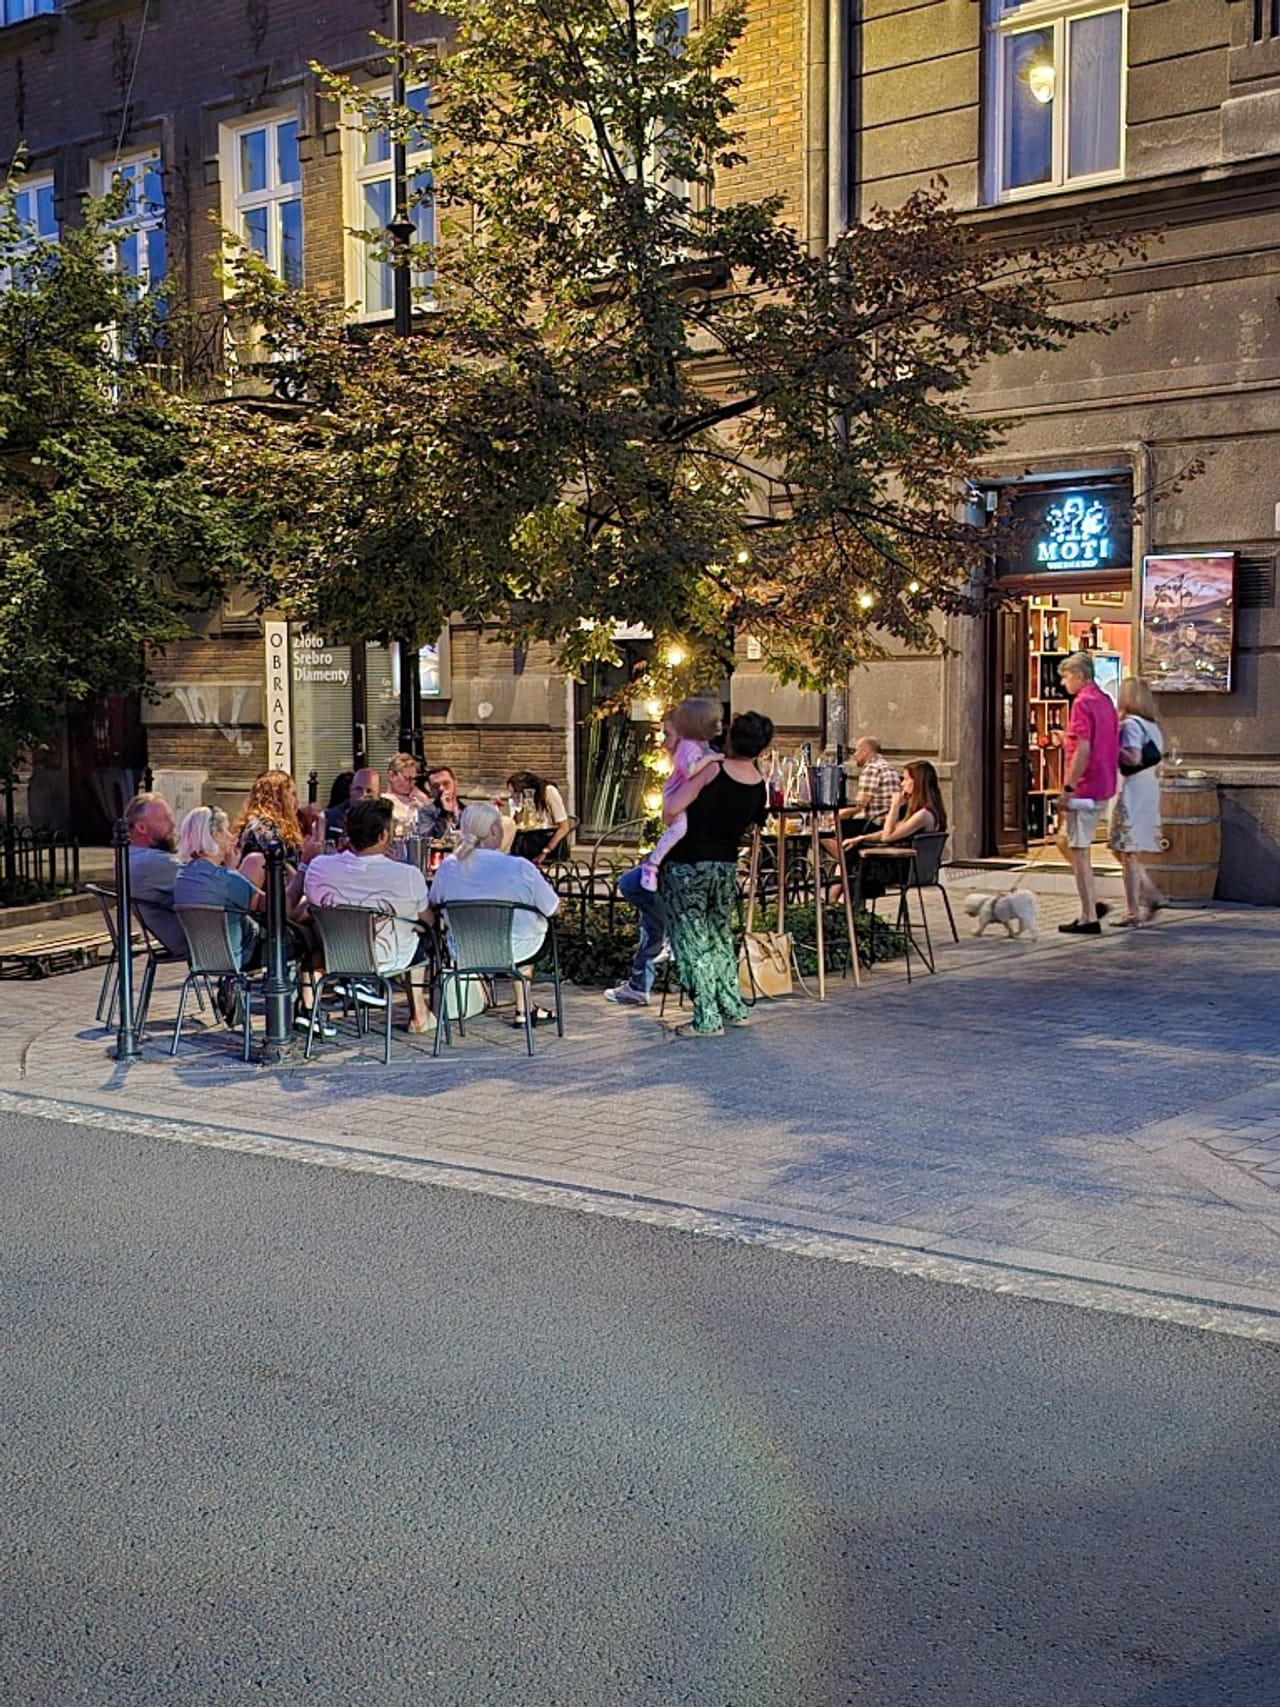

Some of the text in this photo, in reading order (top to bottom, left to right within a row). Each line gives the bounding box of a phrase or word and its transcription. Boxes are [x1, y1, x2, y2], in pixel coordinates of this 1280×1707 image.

[1037, 538, 1108, 561] MOTI
[292, 650, 333, 665] Srebro
[293, 667, 350, 685] Diamenty
